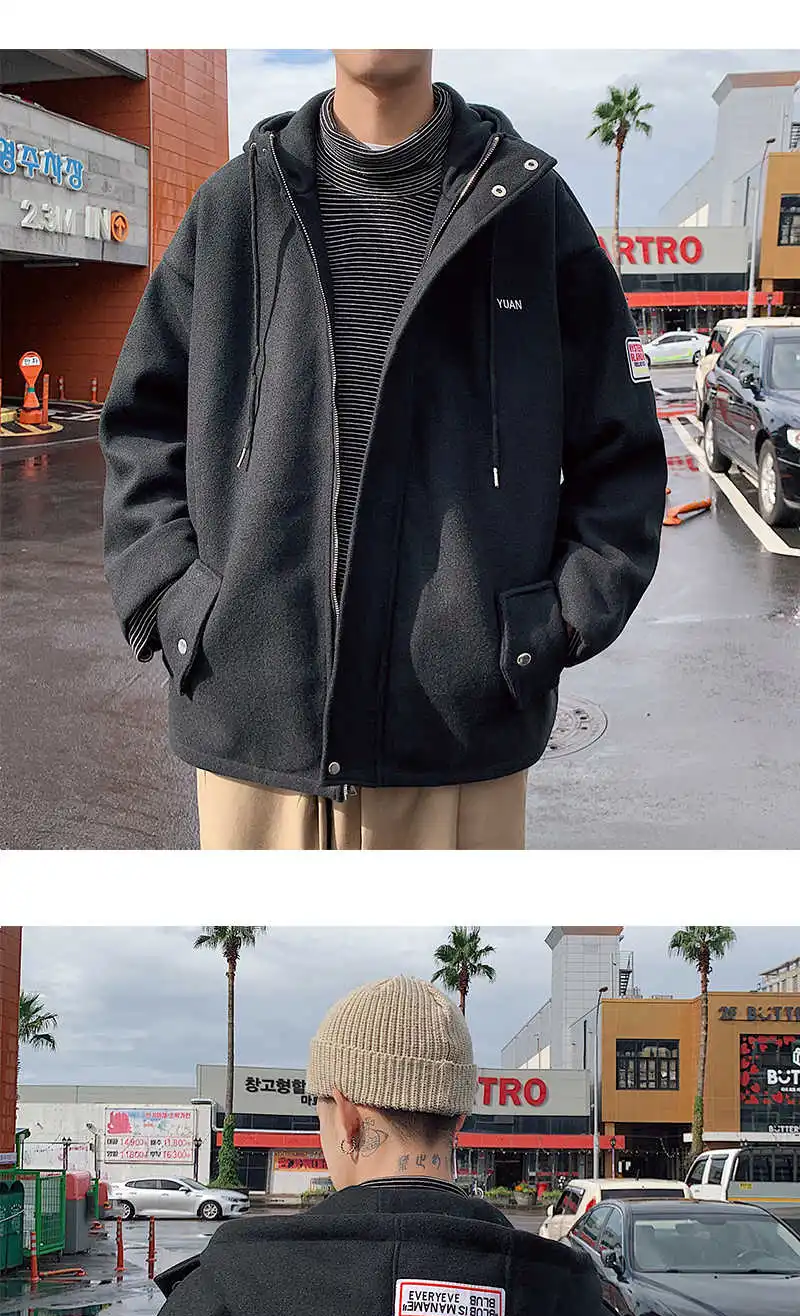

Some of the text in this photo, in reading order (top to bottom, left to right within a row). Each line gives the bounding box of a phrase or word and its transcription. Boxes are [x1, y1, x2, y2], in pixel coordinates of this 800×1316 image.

[496, 298, 523, 310] YUAN
[408, 1290, 460, 1304] EVERYEVE
[469, 1295, 496, 1309] BLUB
[458, 1305, 468, 1316] IS
